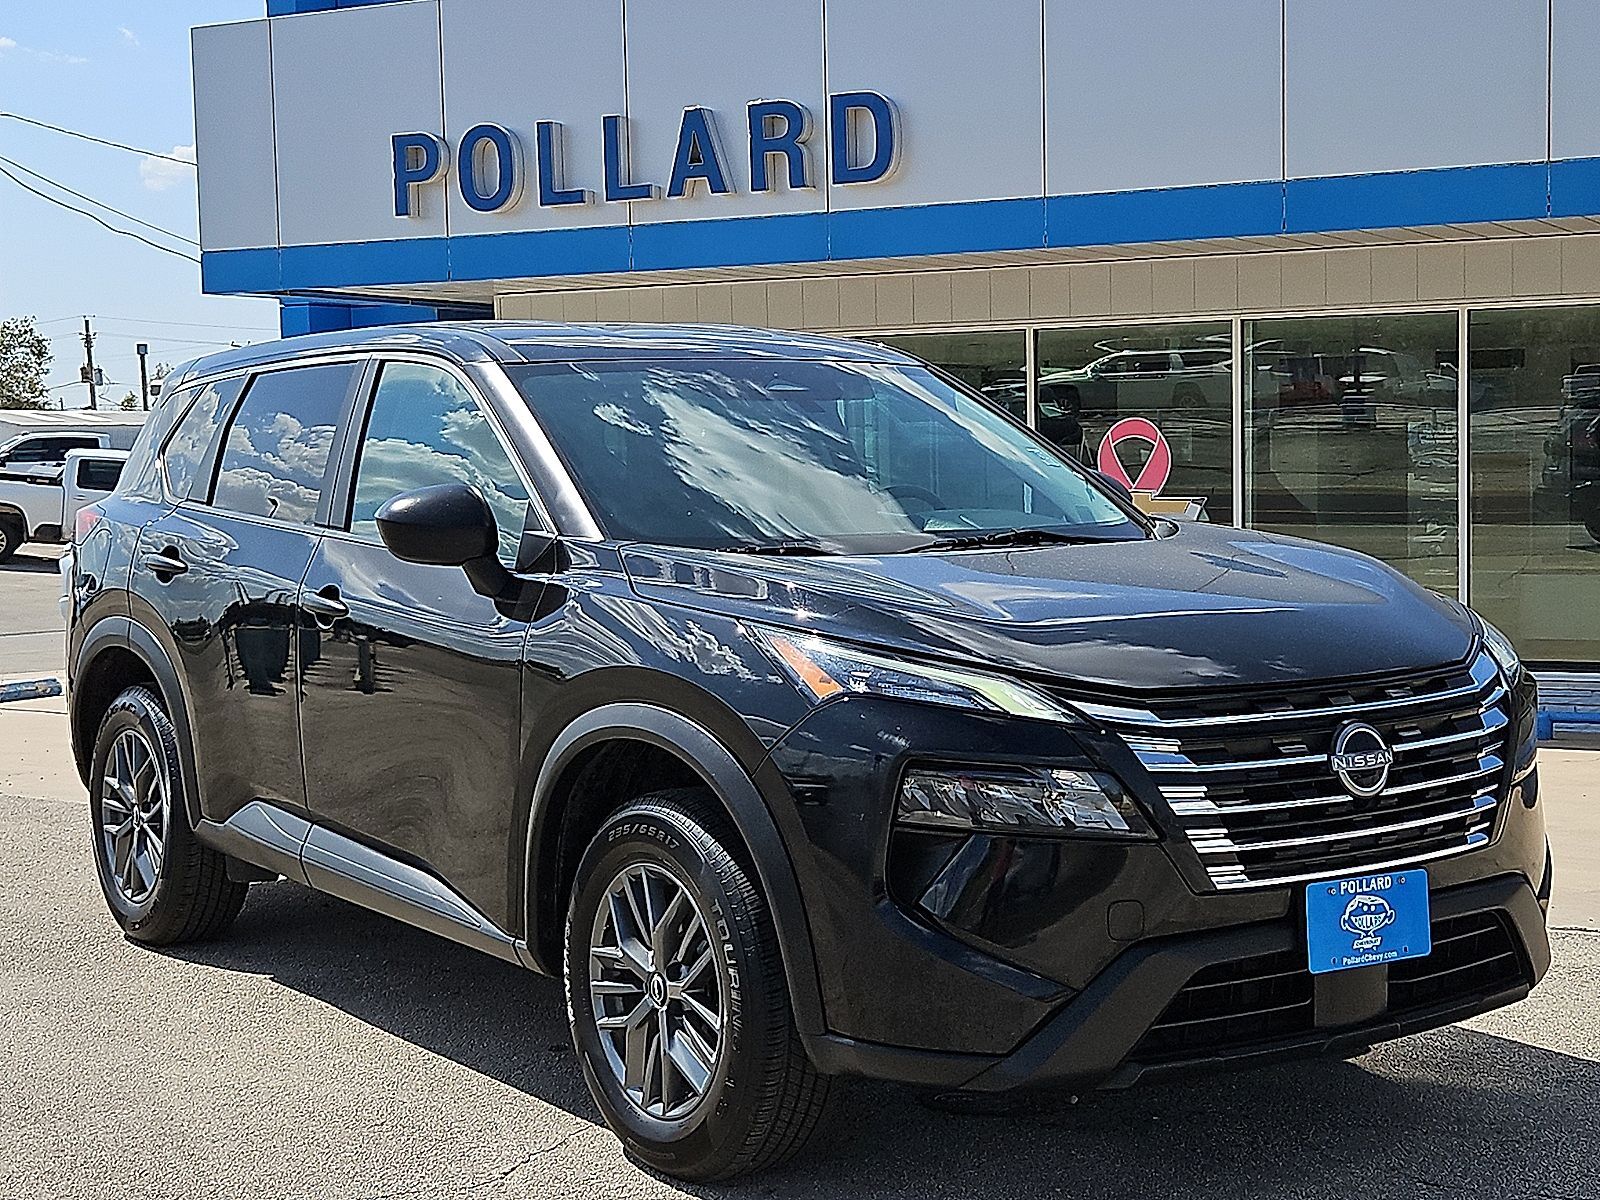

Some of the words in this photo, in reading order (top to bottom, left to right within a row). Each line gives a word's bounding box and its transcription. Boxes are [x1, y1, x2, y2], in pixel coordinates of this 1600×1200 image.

[390, 90, 903, 218] POLLARD
[1333, 749, 1393, 769] NISSAN
[608, 823, 680, 849] 235/65R17
[1340, 876, 1392, 895] POLLARD
[1342, 951, 1398, 966] PollardChevy.com
